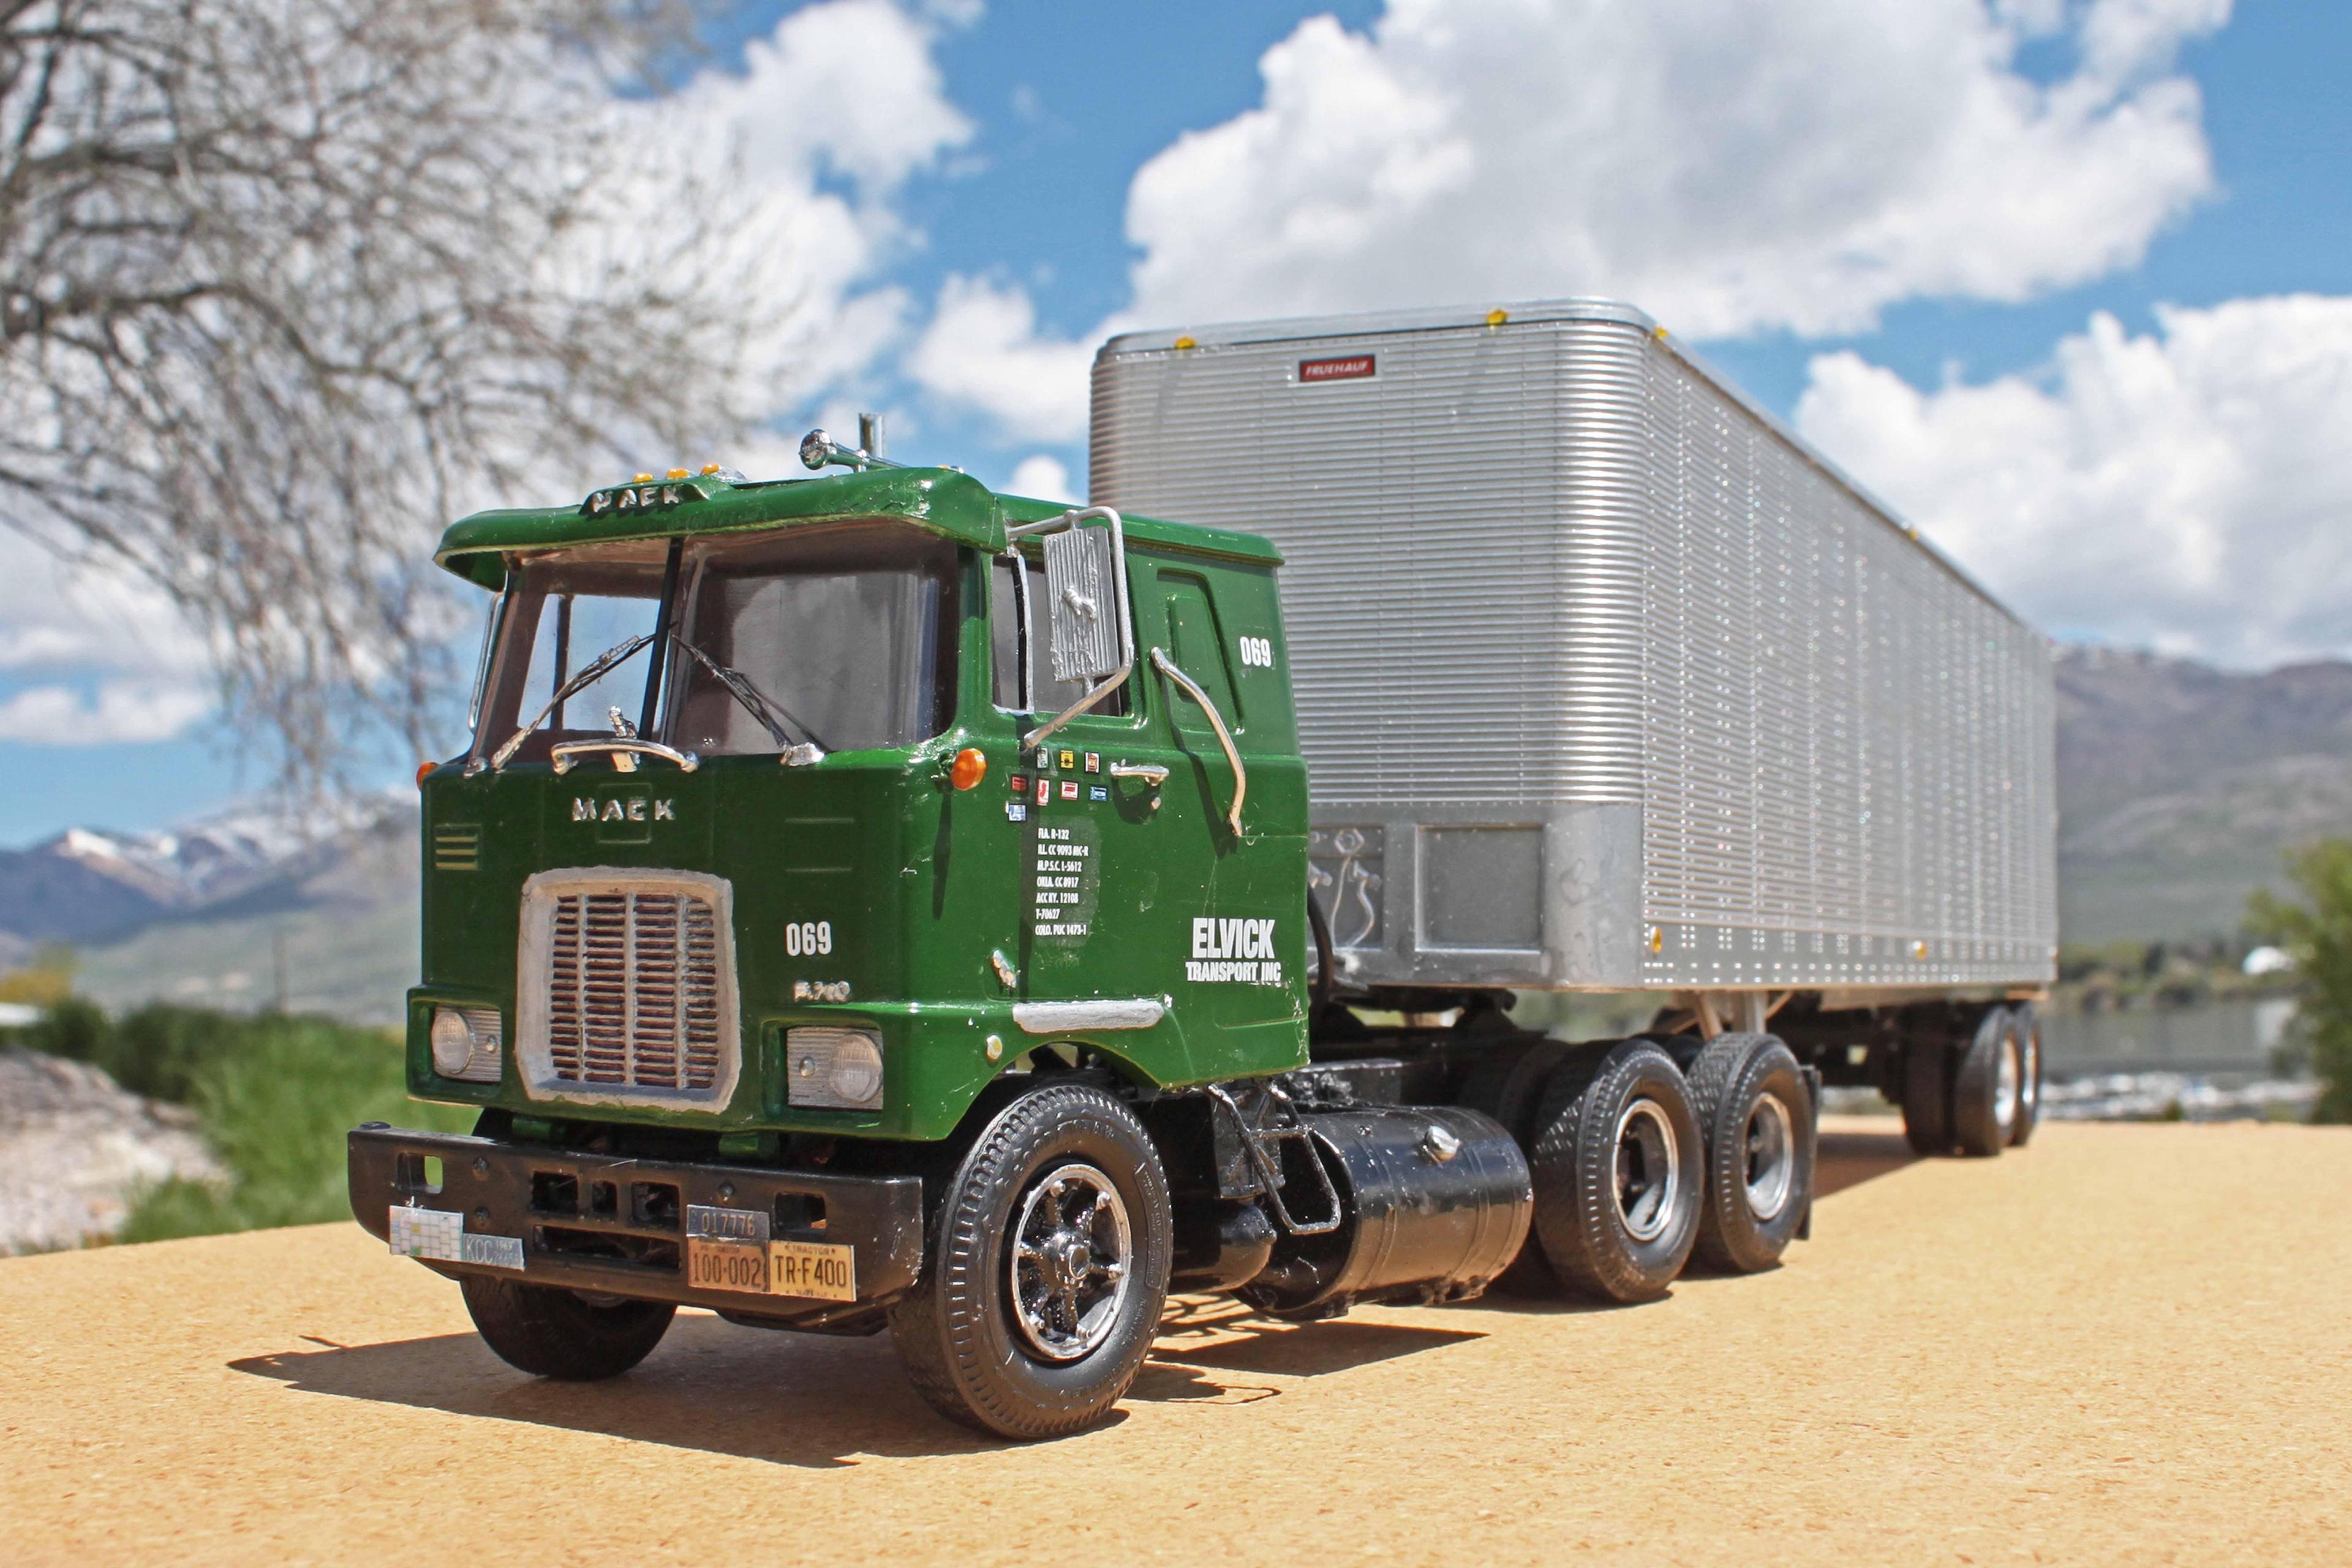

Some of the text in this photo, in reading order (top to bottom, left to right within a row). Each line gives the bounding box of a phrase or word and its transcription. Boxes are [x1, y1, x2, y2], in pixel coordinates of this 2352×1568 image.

[1305, 360, 1368, 376] FRUEHAUF
[592, 486, 680, 513] MACK
[1240, 636, 1272, 667] 069
[572, 797, 677, 821] MACK
[1051, 828, 1069, 840] R-132
[1048, 845, 1056, 856] CC
[1055, 876, 1063, 888] CC
[1063, 876, 1079, 888] 8917
[786, 921, 832, 956] 069
[1053, 924, 1065, 936] PUC
[1193, 918, 1276, 959] ELVICK
[1185, 962, 1281, 982] TRANSPORT INC
[702, 1212, 755, 1237] 017776
